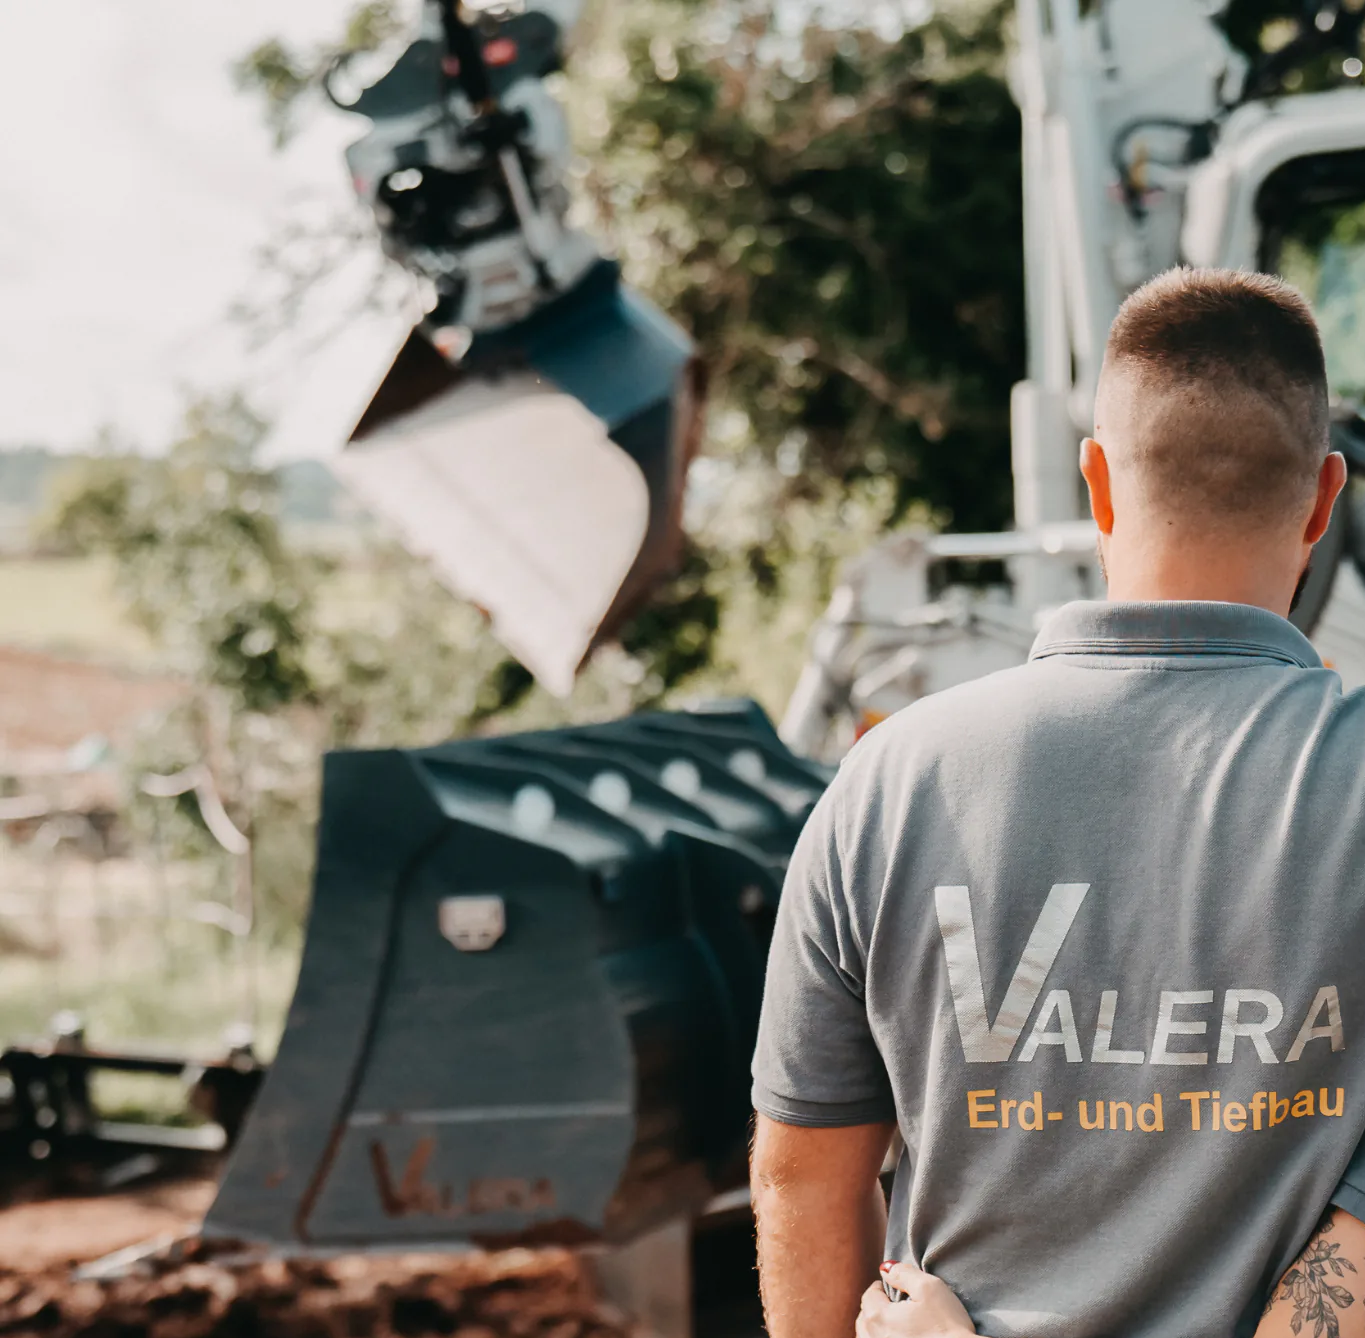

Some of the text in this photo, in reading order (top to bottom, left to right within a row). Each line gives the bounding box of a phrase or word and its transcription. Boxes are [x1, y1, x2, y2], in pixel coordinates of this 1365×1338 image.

[934, 883, 1346, 1065] VALERA
[967, 1087, 1346, 1132] Erd- und Tiefbau
